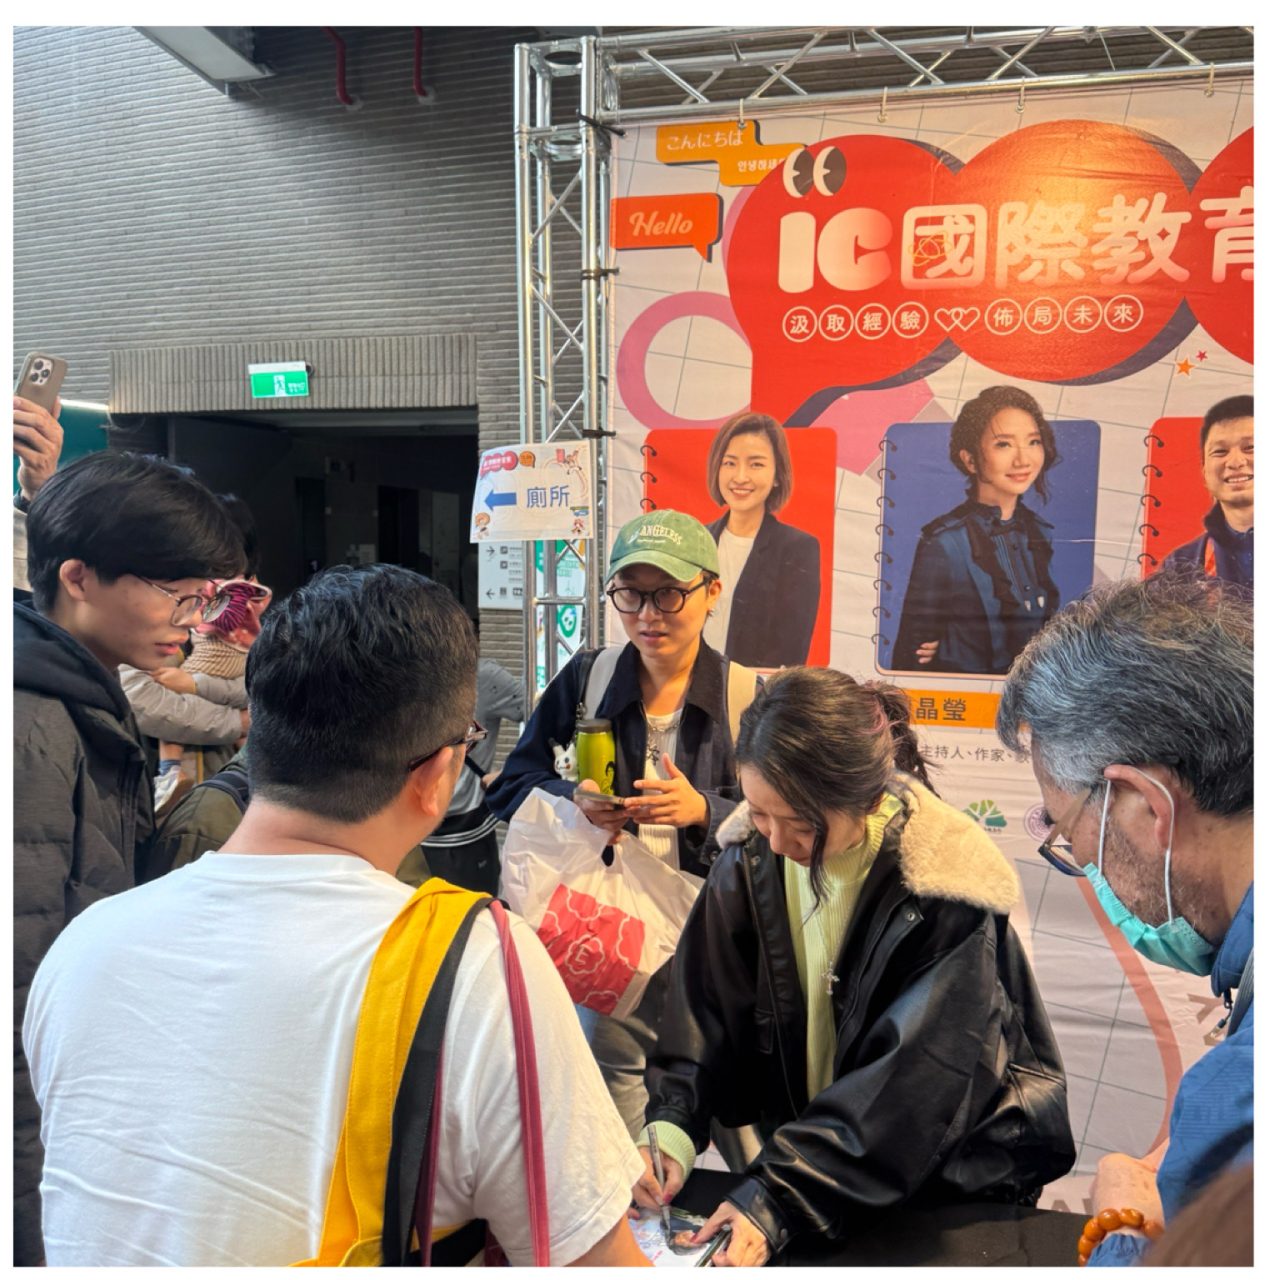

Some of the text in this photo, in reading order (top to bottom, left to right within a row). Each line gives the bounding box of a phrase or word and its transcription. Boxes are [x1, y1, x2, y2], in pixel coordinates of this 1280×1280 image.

[666, 130, 744, 151] こんにちは
[737, 158, 782, 173] 안녕하세
[629, 211, 693, 238] Hello
[782, 294, 1144, 343] 汲取經驗 佈局未來
[526, 485, 570, 508] 廁所
